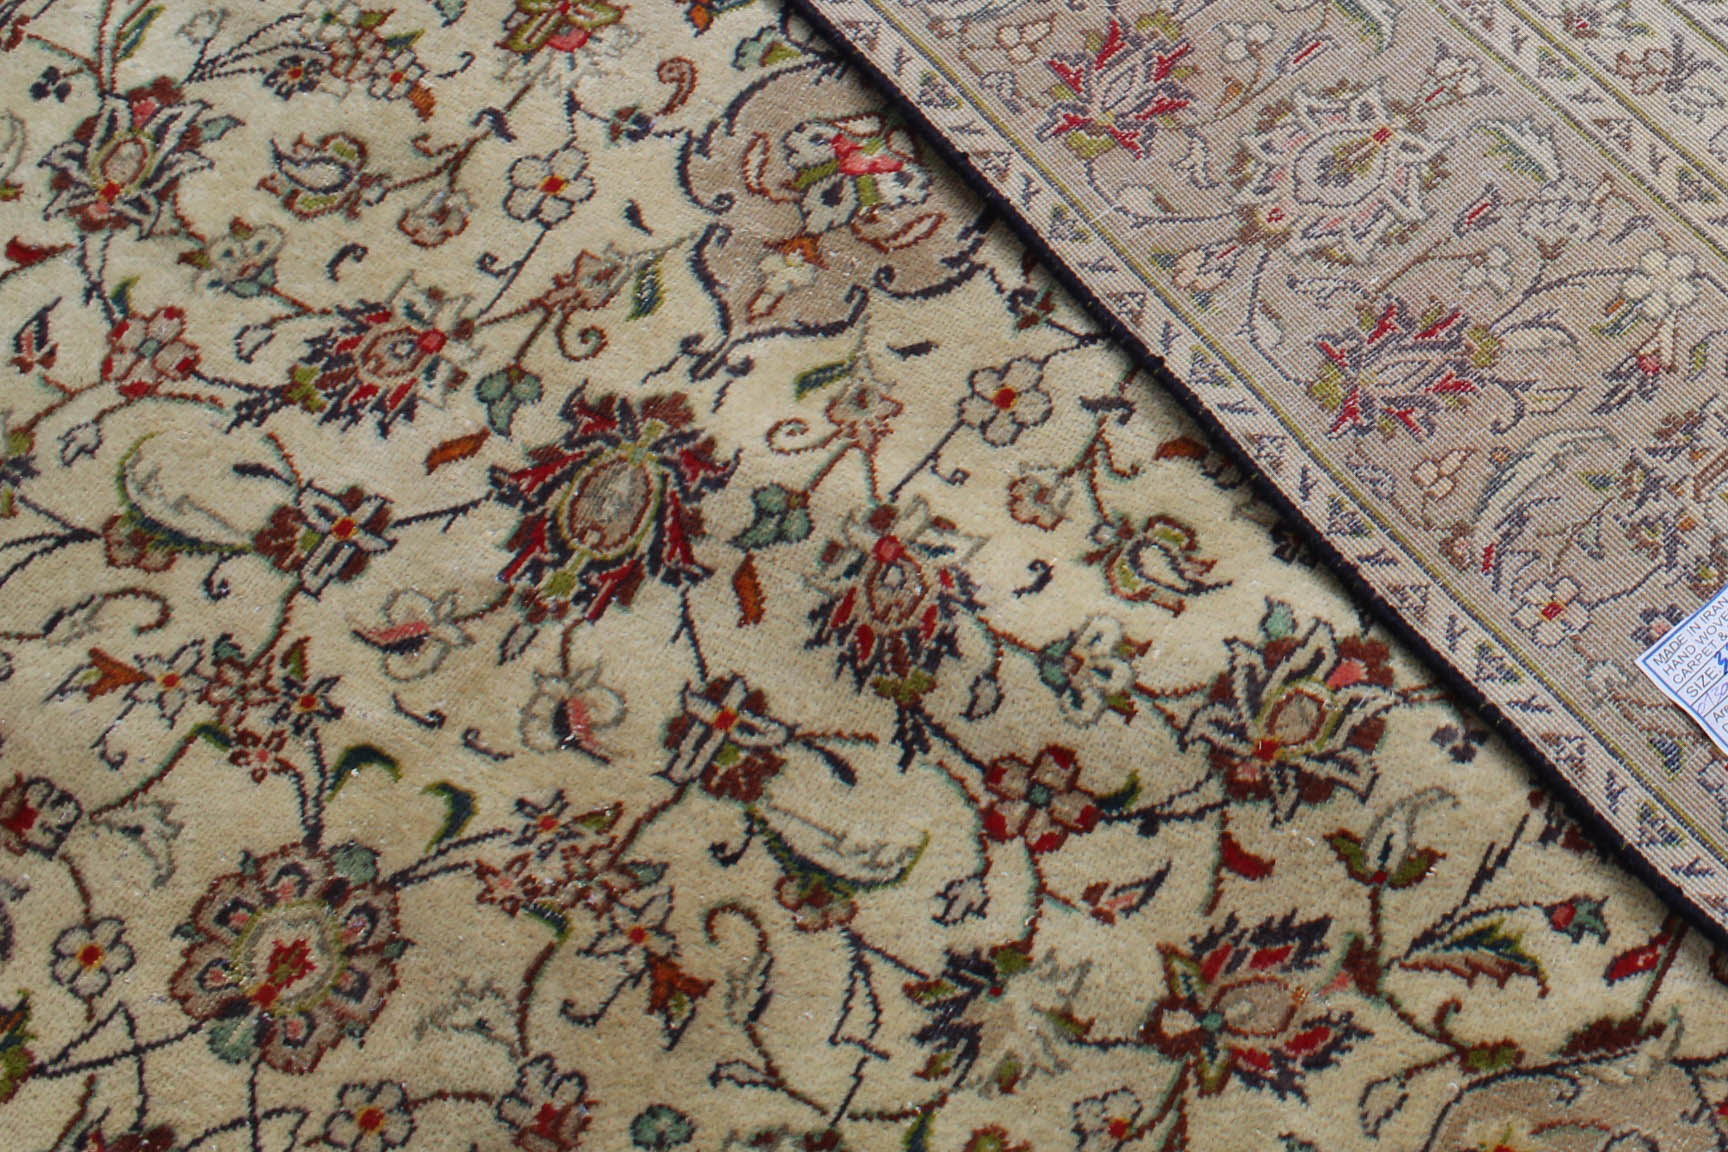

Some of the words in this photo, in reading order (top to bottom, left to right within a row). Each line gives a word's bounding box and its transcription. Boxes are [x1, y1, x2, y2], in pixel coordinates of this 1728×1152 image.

[1653, 634, 1688, 665] MADE
[1687, 622, 1701, 636] IN
[1701, 596, 1728, 624] IRAN
[1663, 644, 1696, 676] HAND
[1673, 639, 1718, 684] CARPET
[1719, 631, 1728, 641] &
